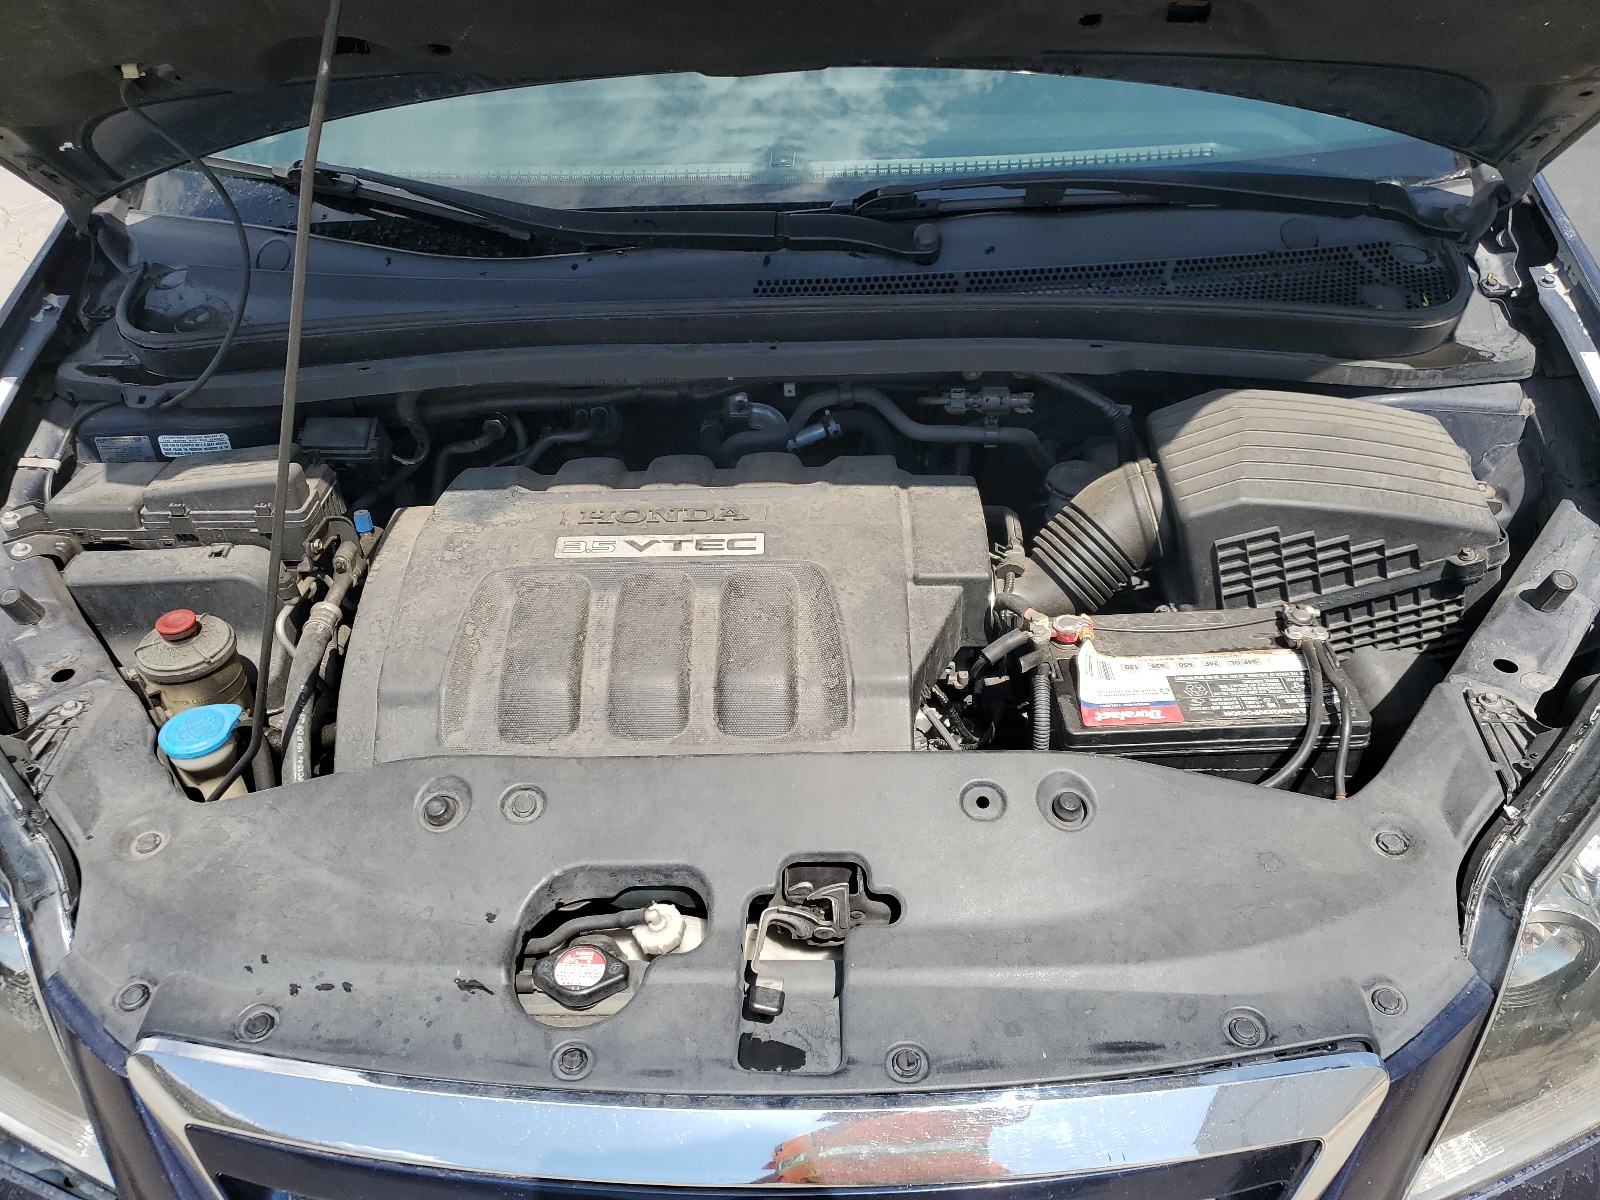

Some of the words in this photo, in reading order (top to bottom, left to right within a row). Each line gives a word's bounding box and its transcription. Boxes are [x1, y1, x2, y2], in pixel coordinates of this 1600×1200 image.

[578, 507, 751, 525] HONDA
[562, 540, 617, 553] 3.5
[624, 537, 758, 553] VTEC
[1094, 709, 1166, 722] Duralast
